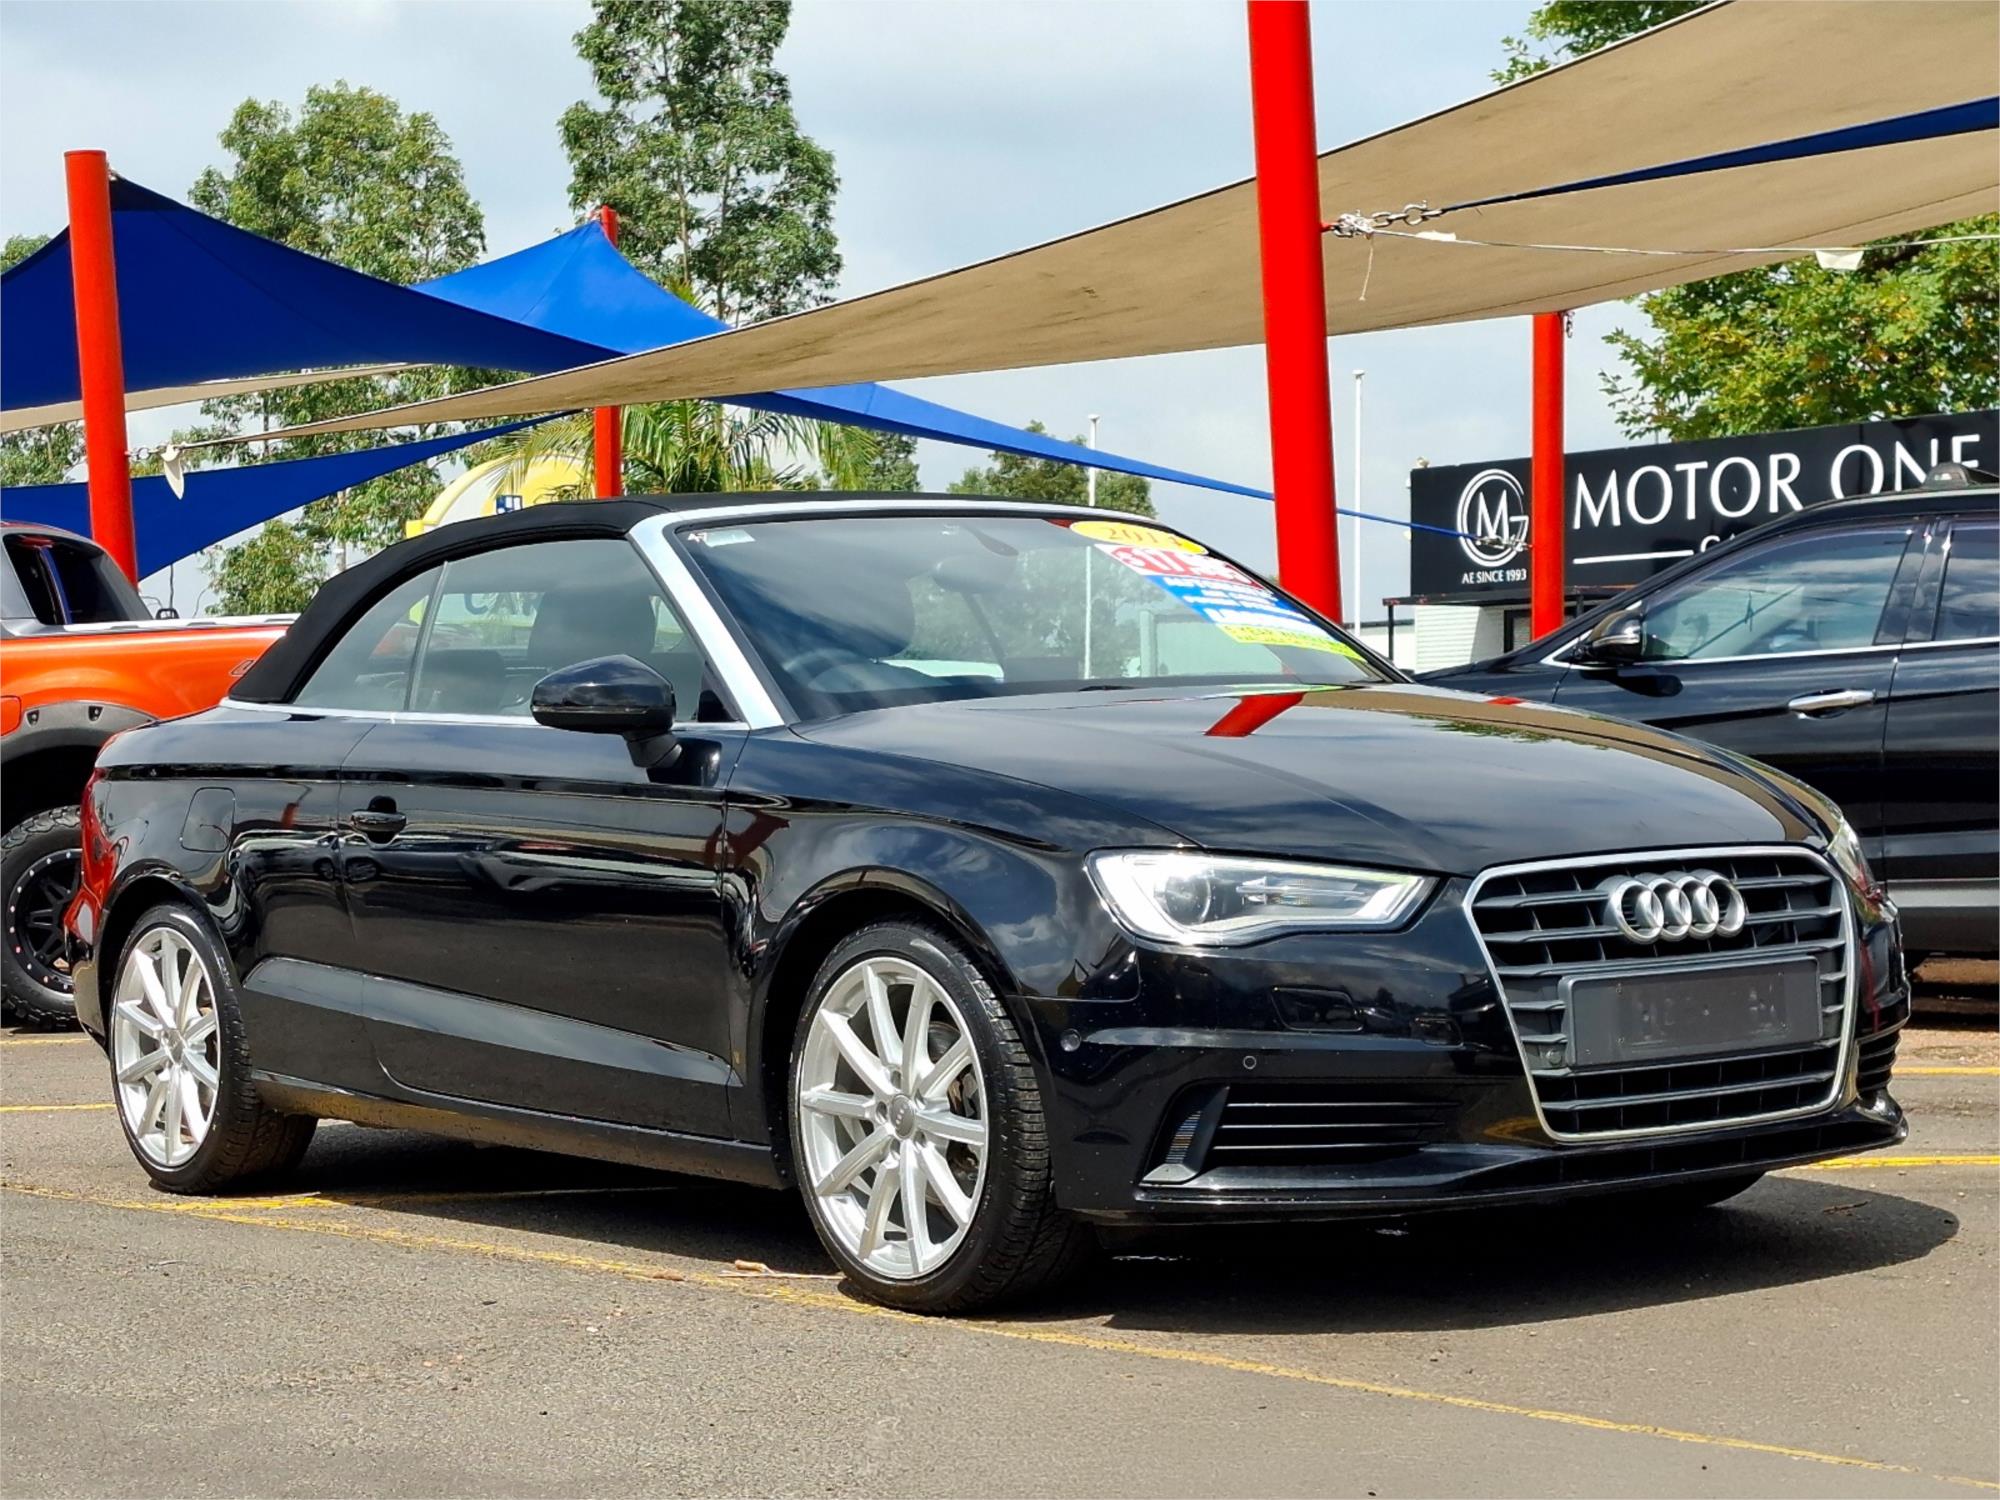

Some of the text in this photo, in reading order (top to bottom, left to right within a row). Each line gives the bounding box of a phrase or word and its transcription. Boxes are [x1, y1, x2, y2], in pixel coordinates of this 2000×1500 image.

[1573, 434, 1980, 530] MOTOR ONE
[1461, 568, 1527, 584] AE SINCE 1993
